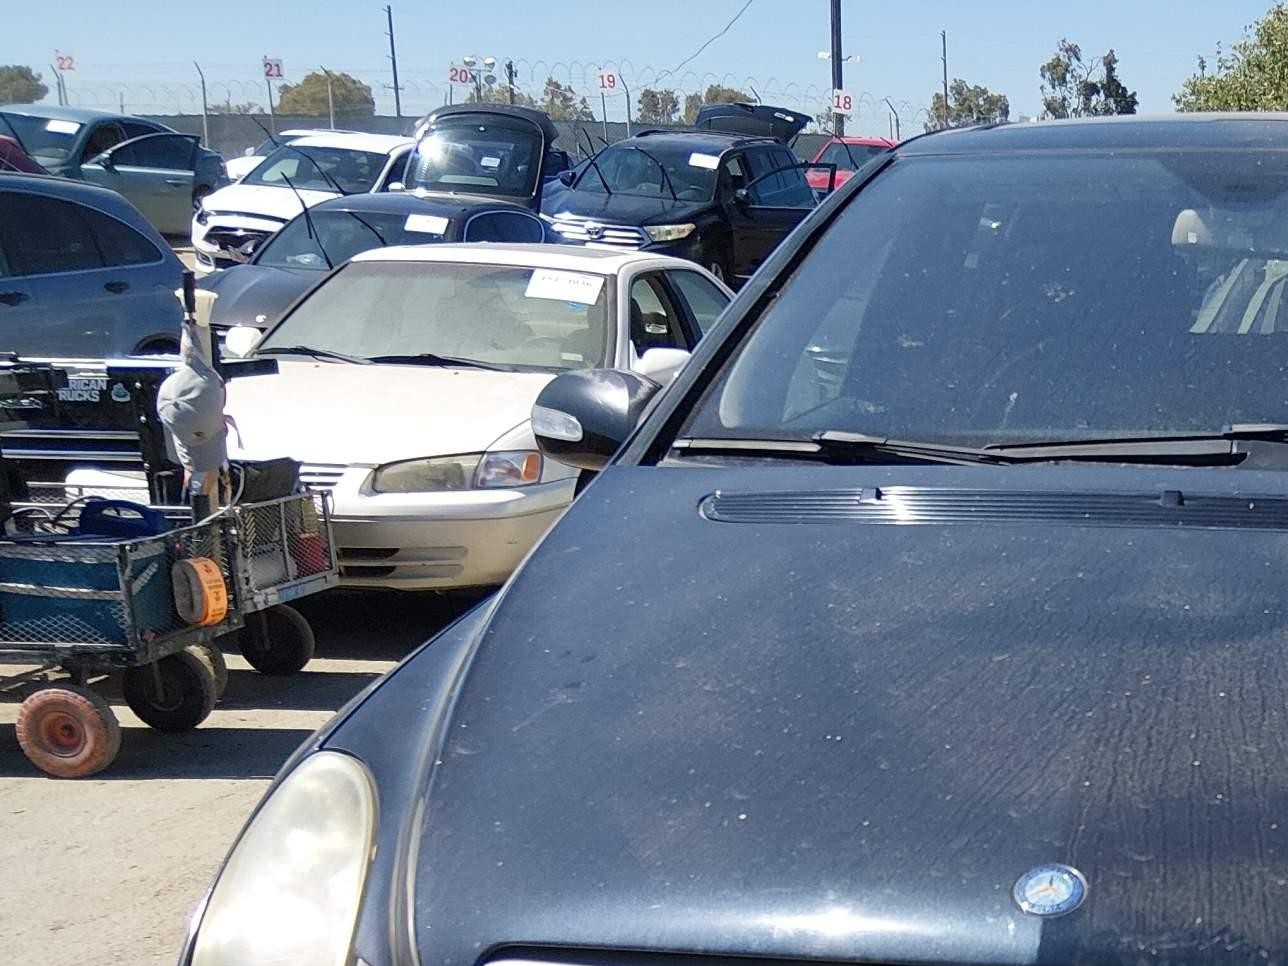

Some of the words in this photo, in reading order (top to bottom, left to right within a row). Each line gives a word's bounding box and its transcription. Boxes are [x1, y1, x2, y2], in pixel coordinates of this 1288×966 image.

[56, 56, 74, 70] 22
[264, 62, 283, 77] 21
[450, 67, 469, 83] 20
[598, 74, 616, 88] 19
[834, 95, 852, 110] 18
[64, 379, 107, 391] RICAN
[56, 389, 101, 402] TRUCKS
